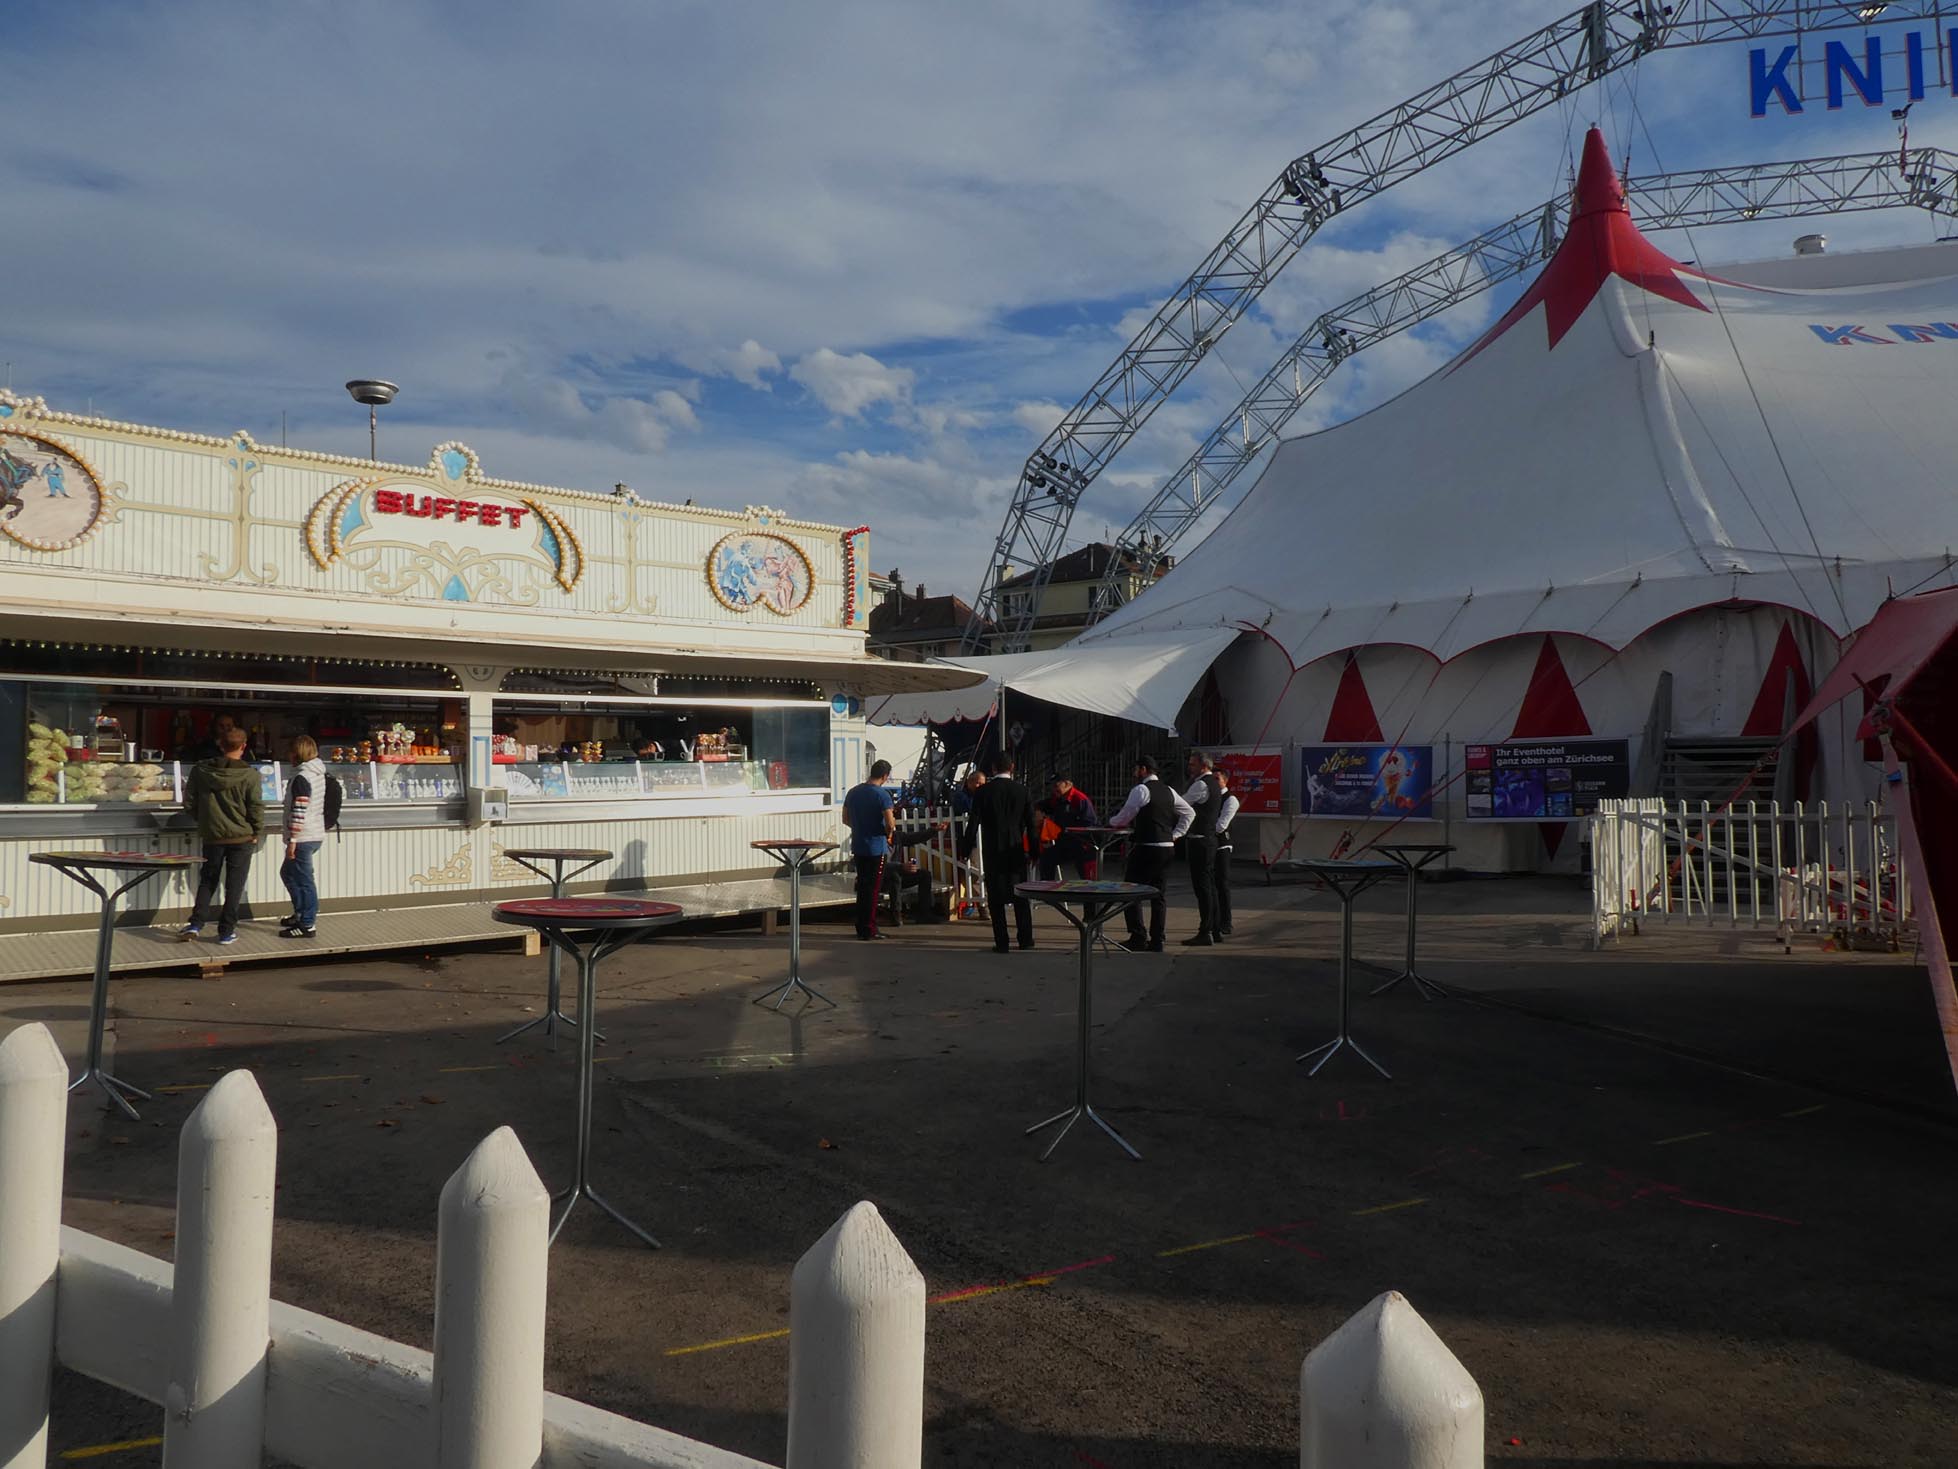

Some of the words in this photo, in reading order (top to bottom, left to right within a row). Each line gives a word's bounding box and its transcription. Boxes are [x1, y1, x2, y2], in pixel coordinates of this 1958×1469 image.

[1749, 28, 1958, 118] KNI
[376, 490, 530, 528] BUFFET
[1496, 749, 1511, 757] Ihr
[1513, 747, 1565, 756] Eventhotel
[1496, 758, 1519, 766] ganz
[1521, 756, 1545, 764] oben
[1565, 754, 1614, 763] Zürichsee
